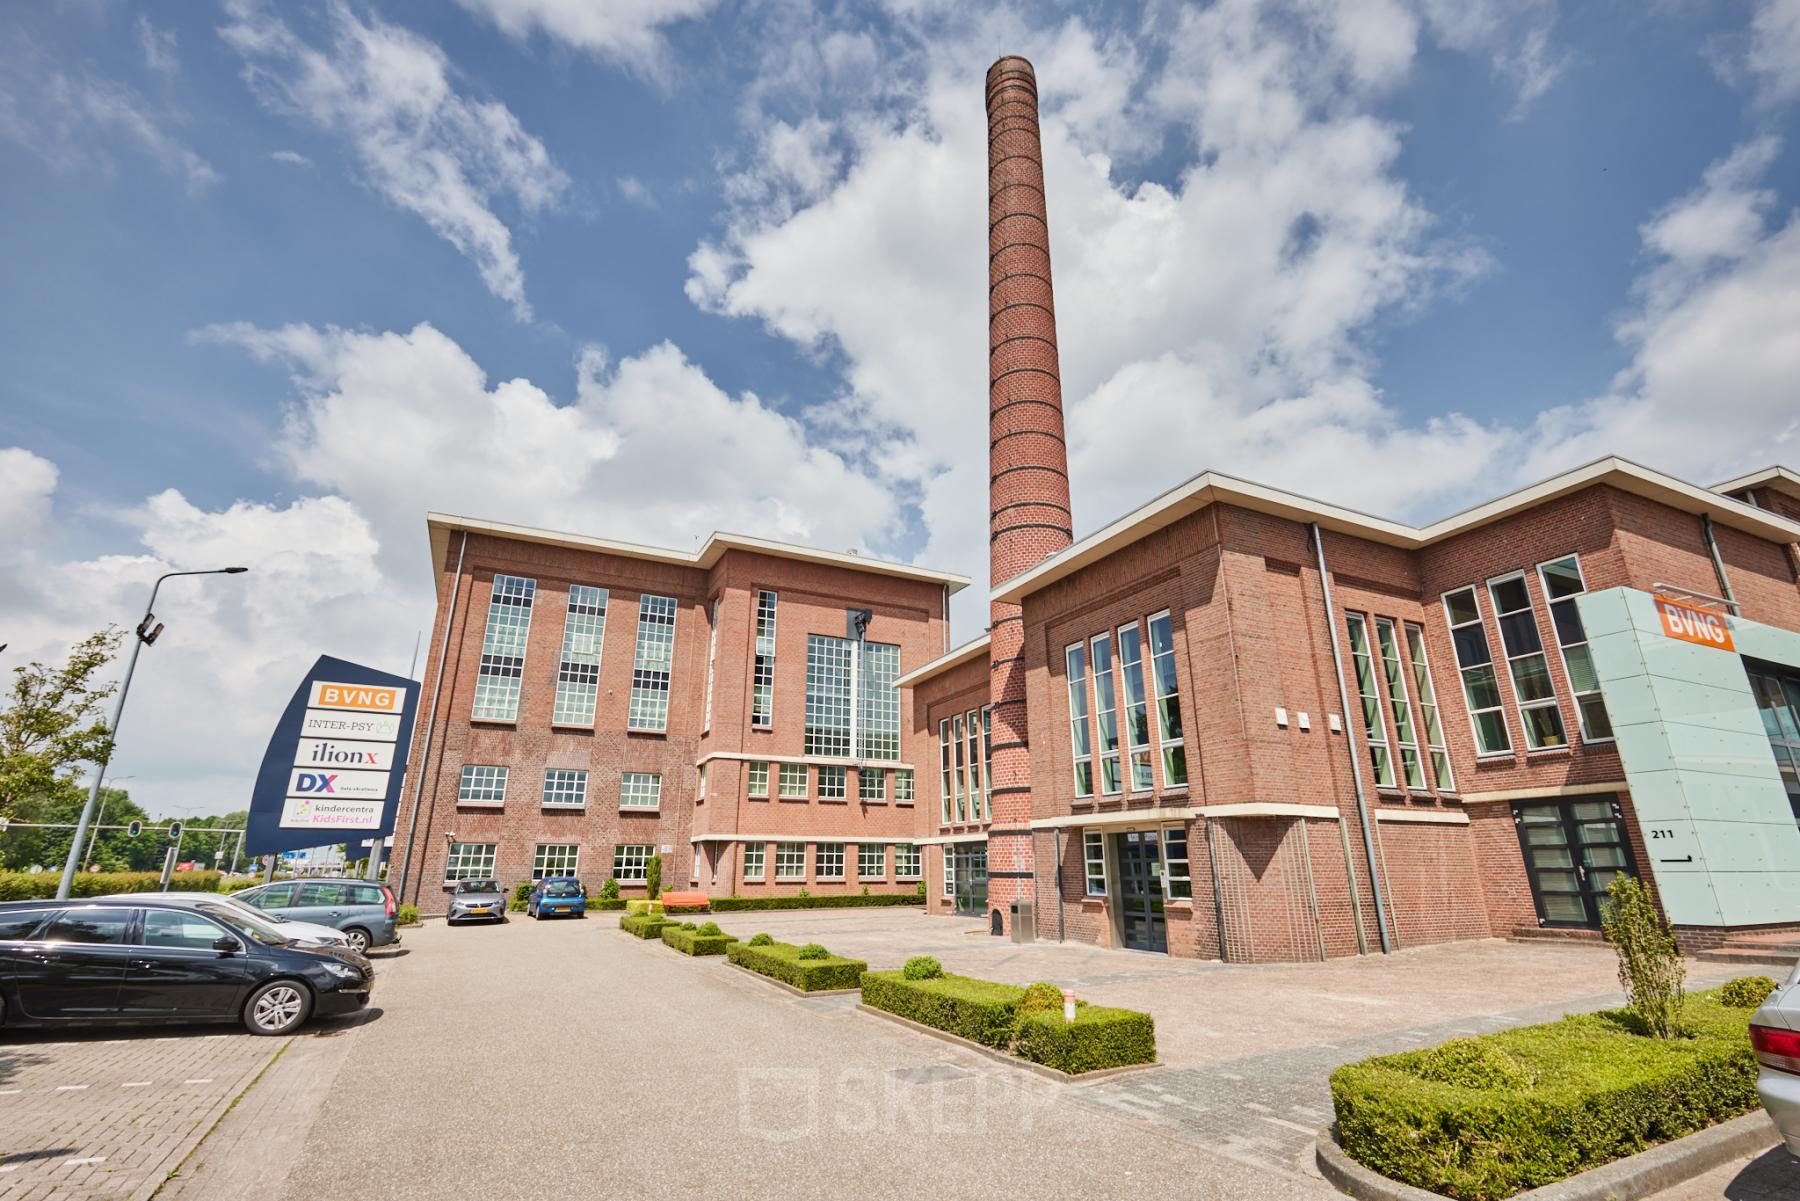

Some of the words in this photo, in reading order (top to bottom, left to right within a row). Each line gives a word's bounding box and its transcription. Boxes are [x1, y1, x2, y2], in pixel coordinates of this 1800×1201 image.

[1666, 604, 1725, 643] BVNG
[324, 688, 390, 706] BVNG
[308, 719, 374, 732] INTER-PSY
[312, 743, 379, 764] ilionx
[295, 773, 338, 792] DX
[315, 804, 374, 813] kindercentra
[312, 815, 372, 824] KidsFirst.nl
[1651, 829, 1674, 839] 211
